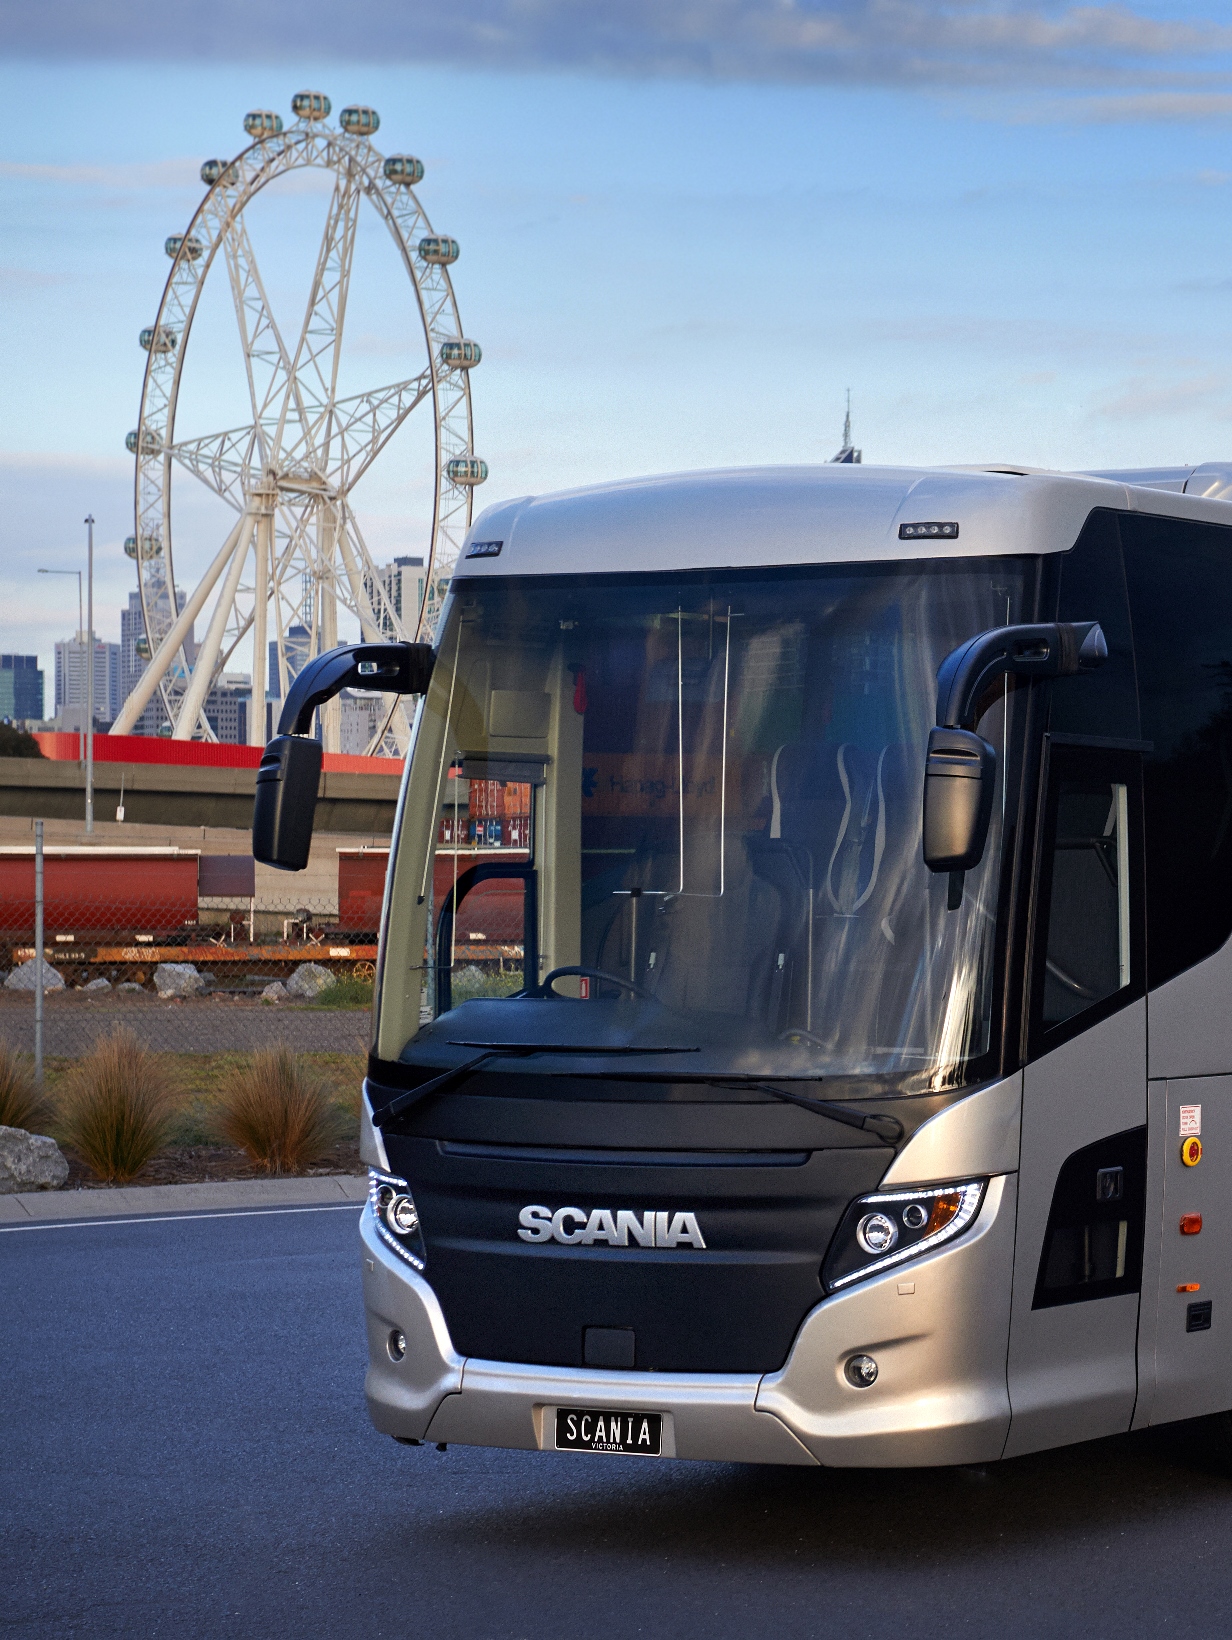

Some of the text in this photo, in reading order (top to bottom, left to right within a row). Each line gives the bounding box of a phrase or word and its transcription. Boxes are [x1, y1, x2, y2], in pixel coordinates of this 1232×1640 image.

[516, 1205, 707, 1249] SCANIA
[566, 1413, 651, 1446] SCANIA
[591, 1442, 624, 1451] VICTORIA
